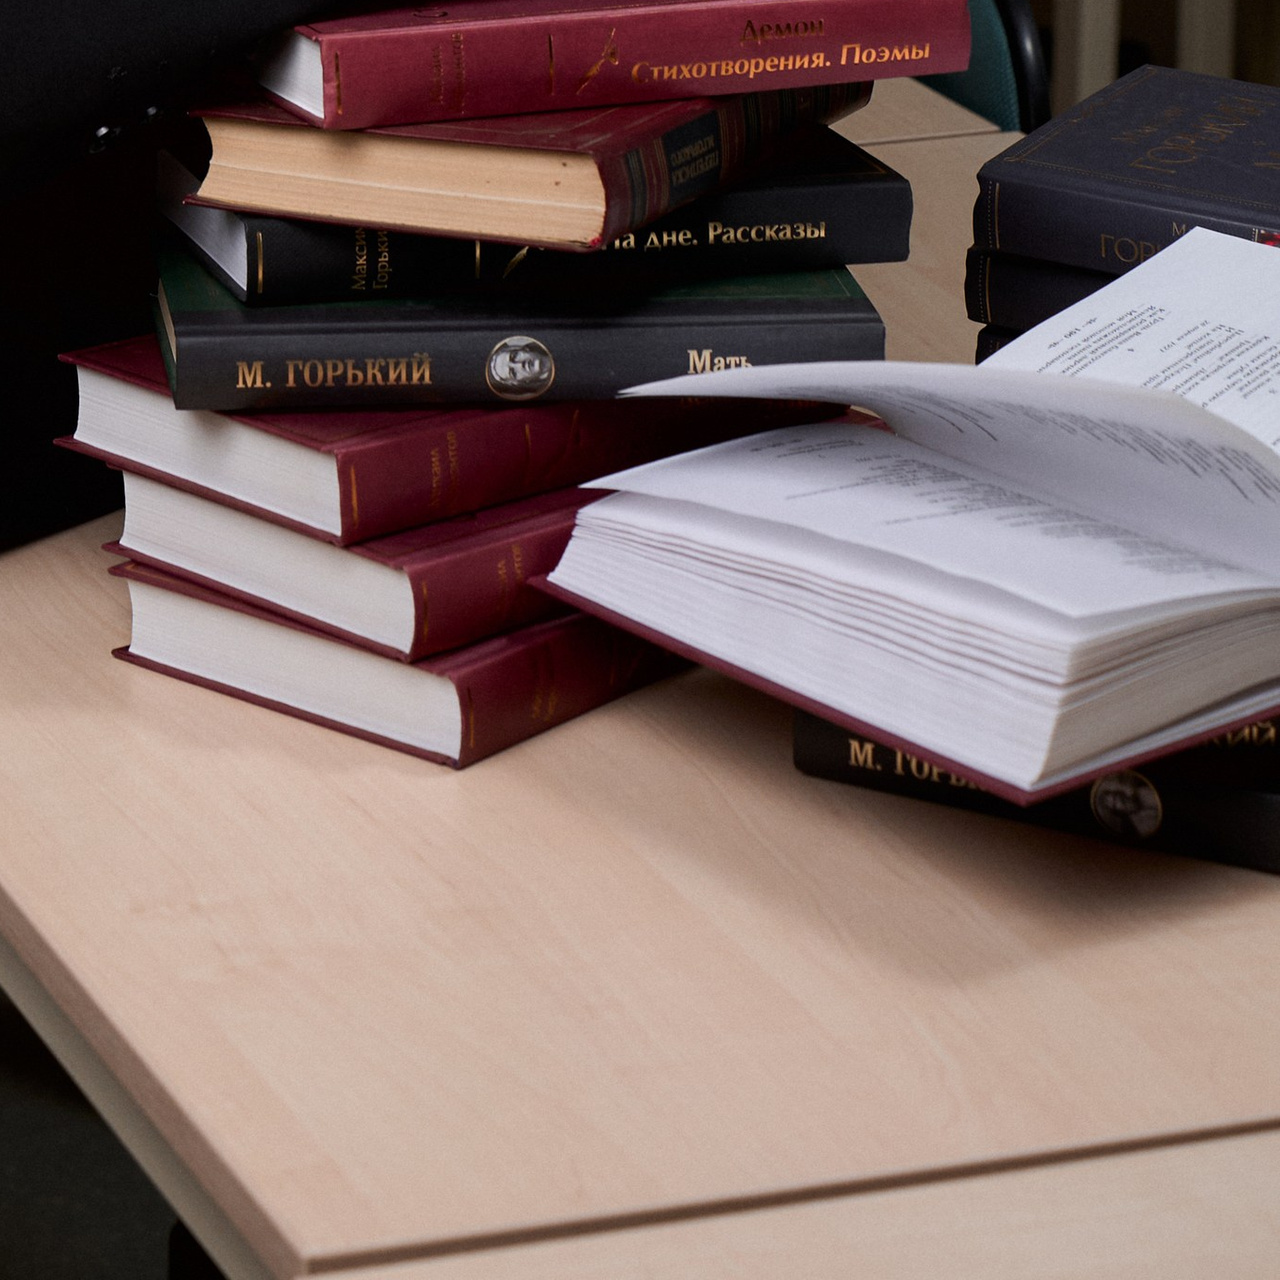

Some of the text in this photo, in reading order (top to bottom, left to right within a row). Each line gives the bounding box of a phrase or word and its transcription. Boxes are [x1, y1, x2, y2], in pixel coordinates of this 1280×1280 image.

[740, 18, 825, 45] Демон
[631, 42, 931, 85] Стихотворения. Поэмы
[643, 228, 699, 253] дне.
[707, 221, 826, 245] Рассказы
[1100, 233, 1161, 263] ГОР
[372, 230, 393, 291] Горьки
[236, 352, 433, 389] М. ГОРЬКИЙ
[687, 348, 754, 374] Мать
[848, 738, 882, 772] М.
